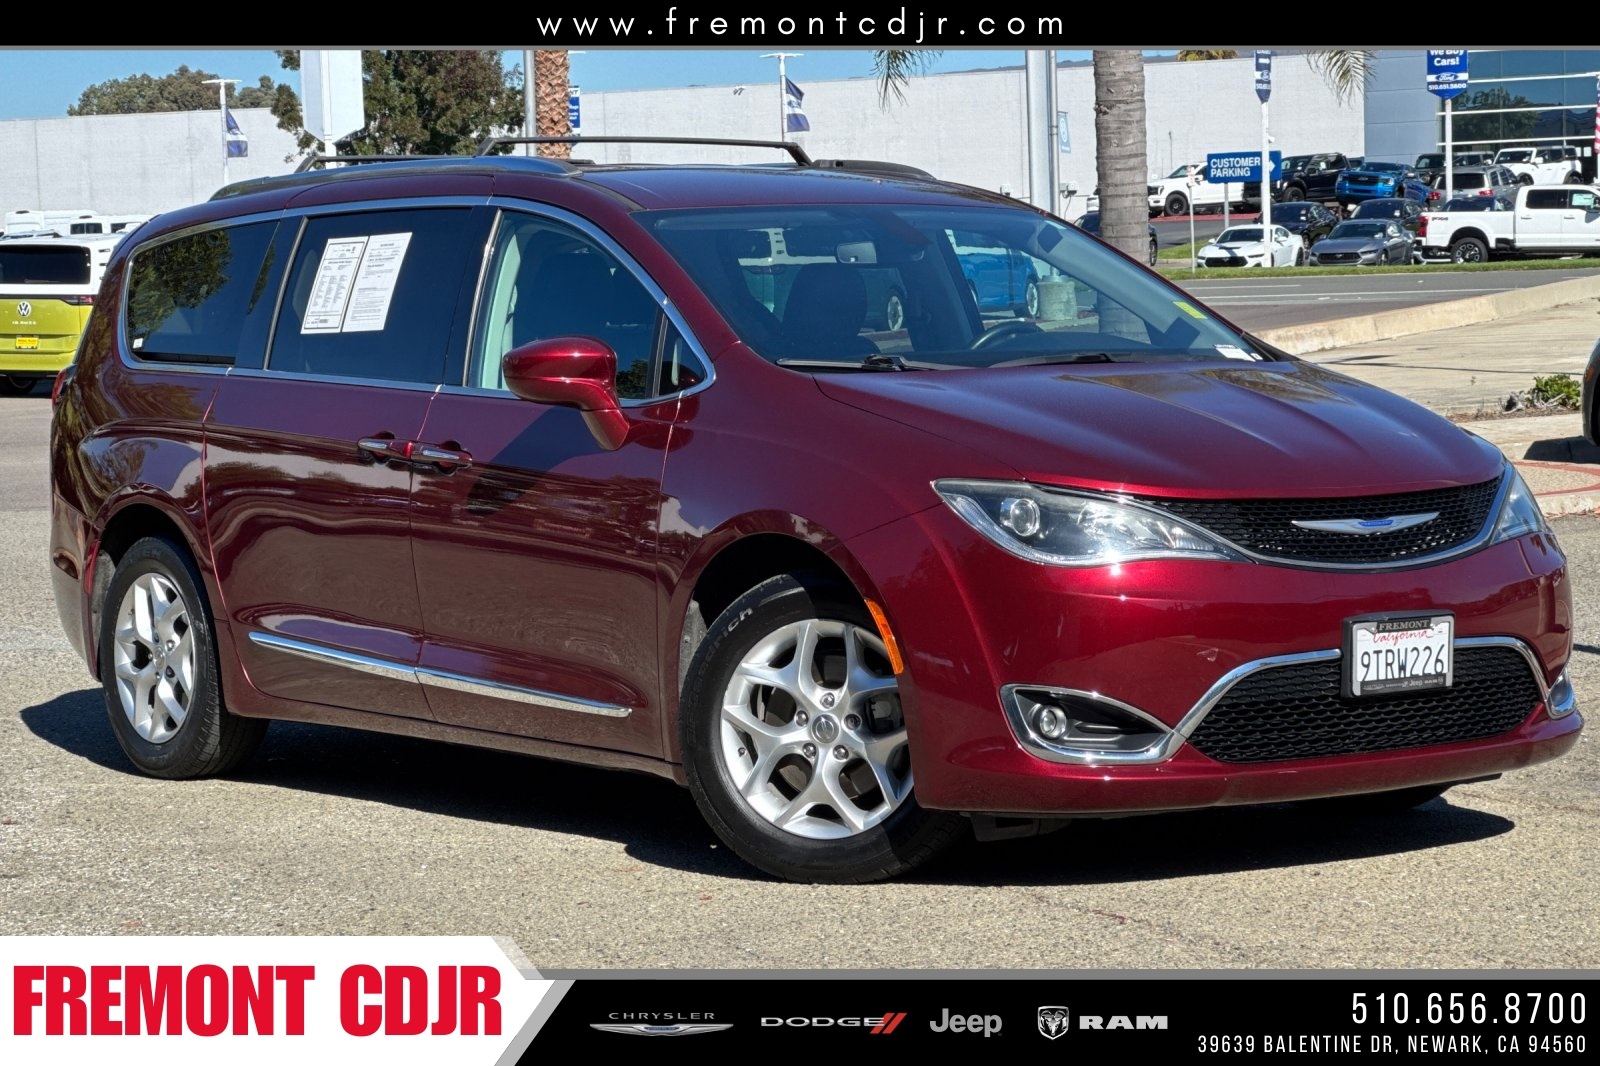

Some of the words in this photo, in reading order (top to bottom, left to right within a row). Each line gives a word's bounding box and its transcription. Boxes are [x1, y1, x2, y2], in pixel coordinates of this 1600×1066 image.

[1434, 57, 1460, 67] Cars!
[1428, 83, 1467, 91] 510.651.5600
[1210, 156, 1261, 169] CUSTOMER
[1210, 167, 1251, 178] PARKING
[1379, 620, 1430, 631] FREMONT
[1373, 630, 1433, 646] California
[1361, 644, 1445, 681] 9TRW226
